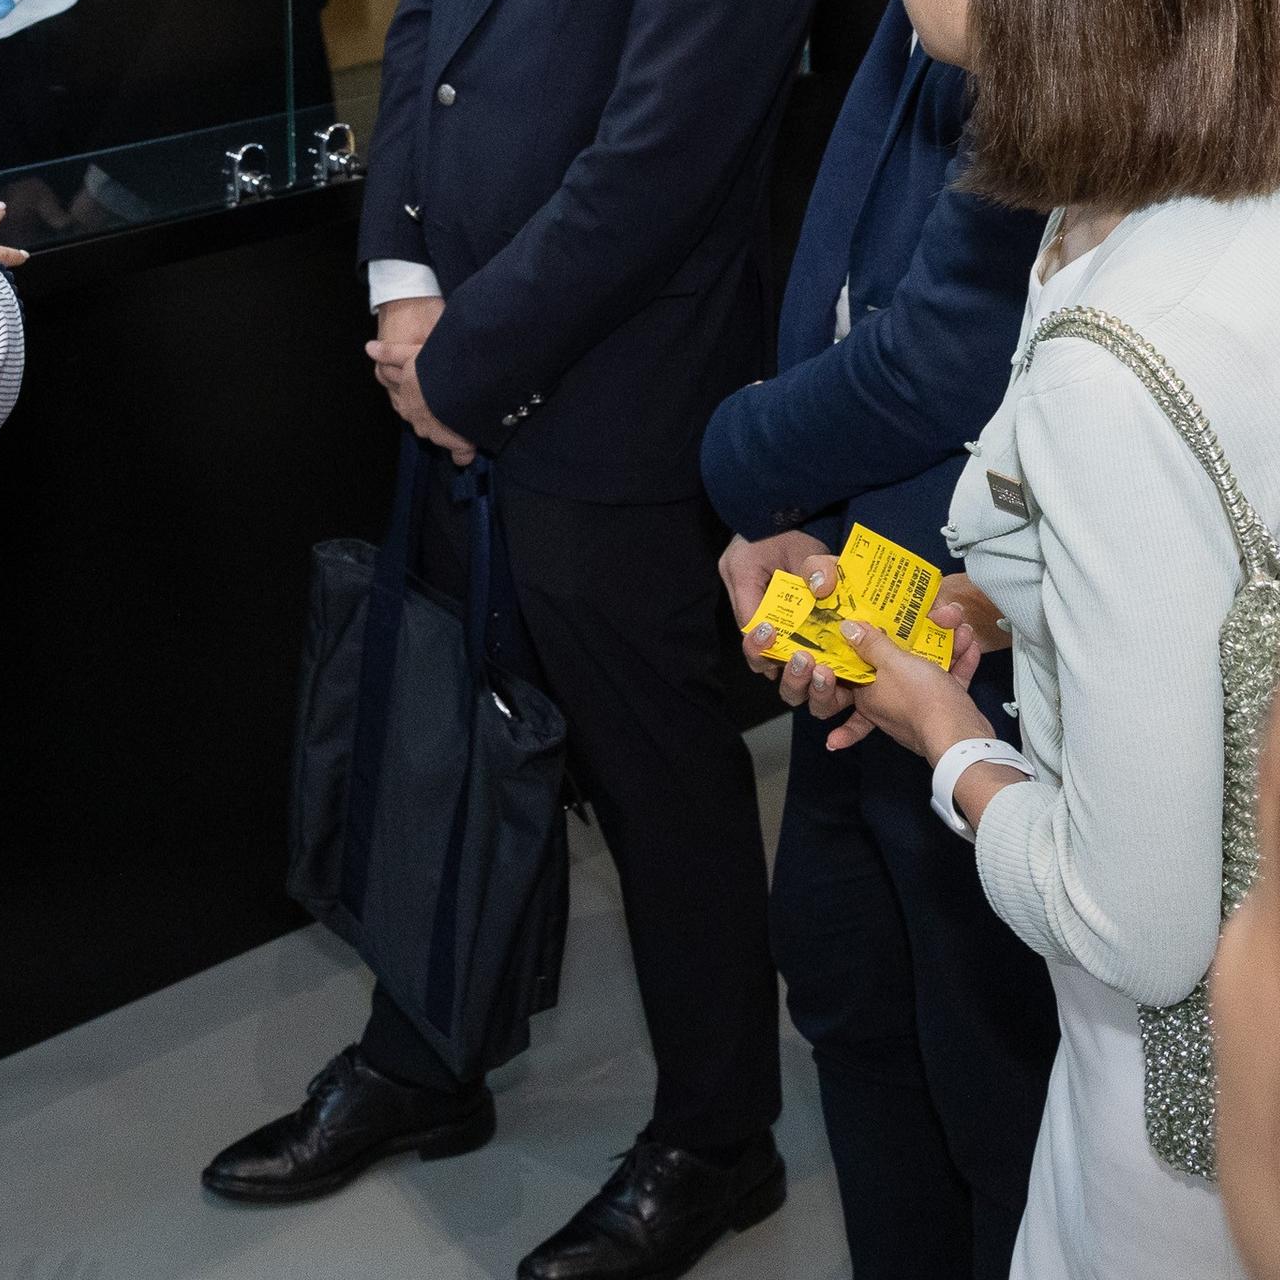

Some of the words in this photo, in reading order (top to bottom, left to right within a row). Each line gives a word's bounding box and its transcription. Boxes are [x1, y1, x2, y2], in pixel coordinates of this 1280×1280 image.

[910, 568, 933, 602] LEGENDS
[907, 597, 922, 612] IN
[895, 606, 918, 642] MOTION
